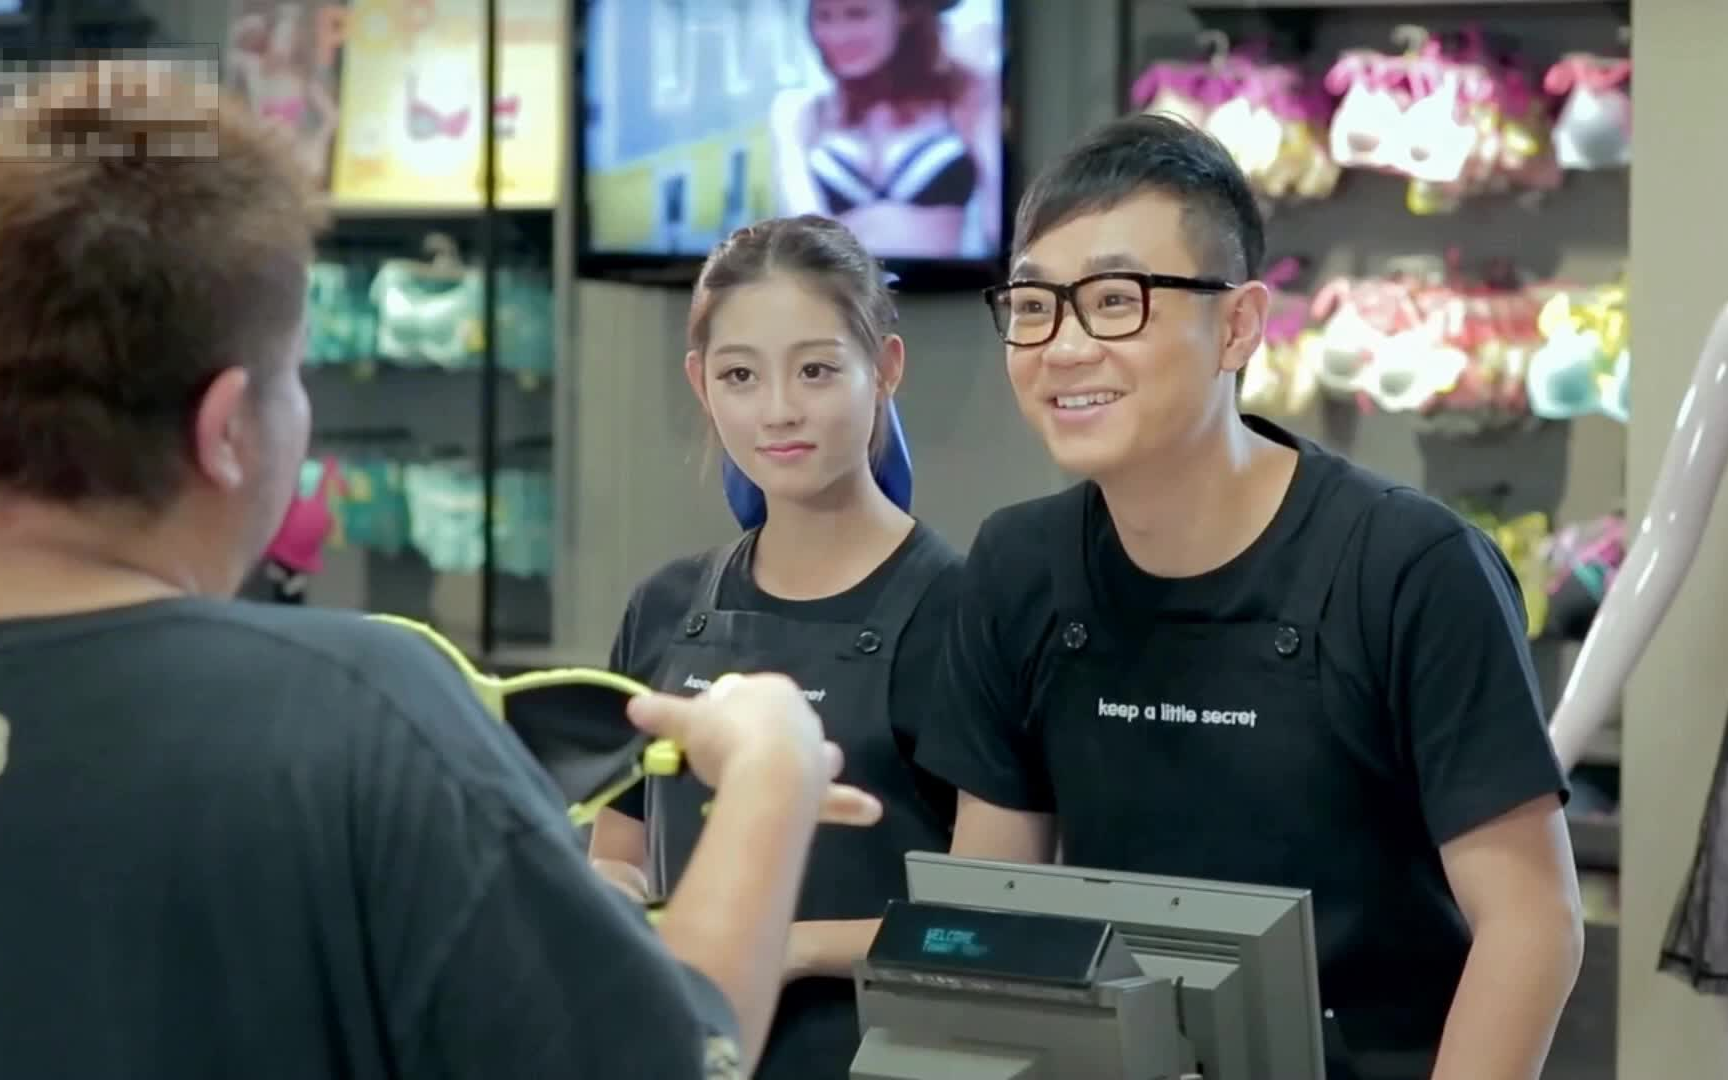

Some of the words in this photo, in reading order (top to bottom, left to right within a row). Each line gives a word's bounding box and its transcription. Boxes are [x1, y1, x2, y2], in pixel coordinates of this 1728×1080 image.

[1098, 697, 1140, 723] keep
[1143, 705, 1156, 721] a
[1160, 702, 1198, 723] little
[1201, 709, 1258, 728] secret
